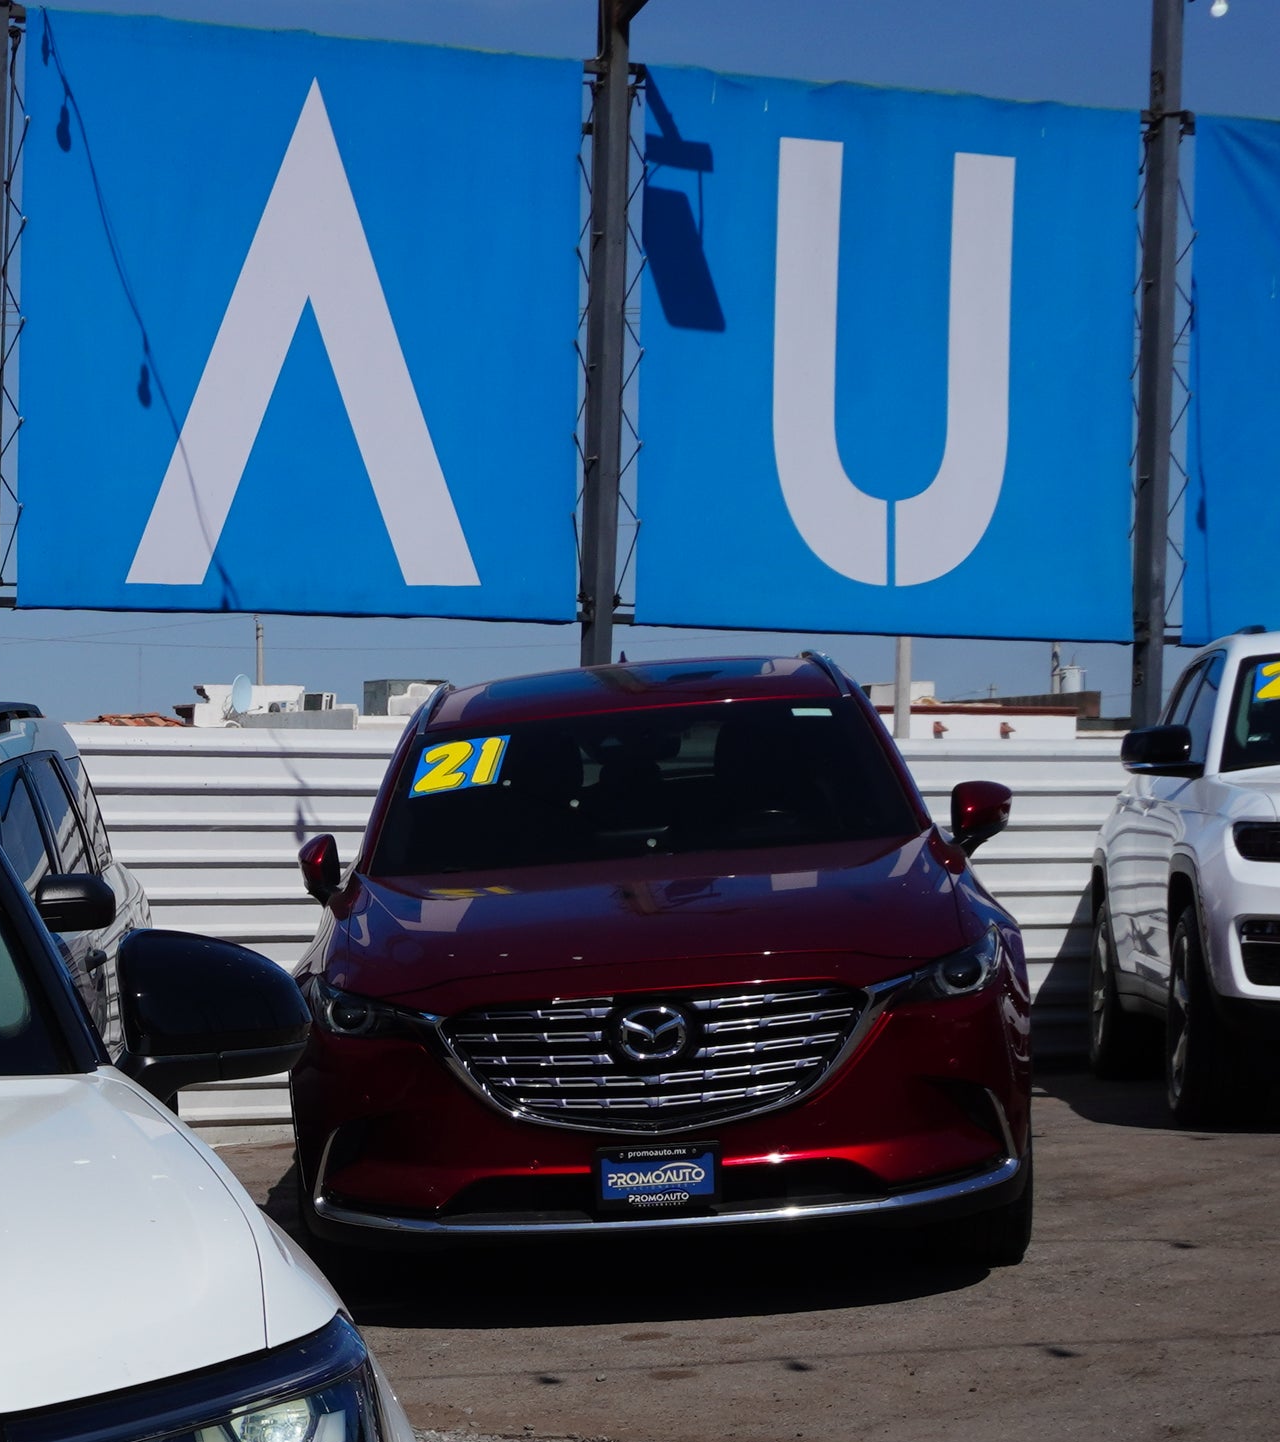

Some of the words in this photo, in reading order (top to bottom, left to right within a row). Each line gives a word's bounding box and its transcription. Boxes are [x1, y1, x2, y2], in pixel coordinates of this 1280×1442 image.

[413, 736, 506, 793] 21
[627, 1148, 687, 1160] promoauto.mx
[607, 1167, 706, 1187] PROMOAUTO
[628, 1192, 690, 1203] PROMOAUTO
